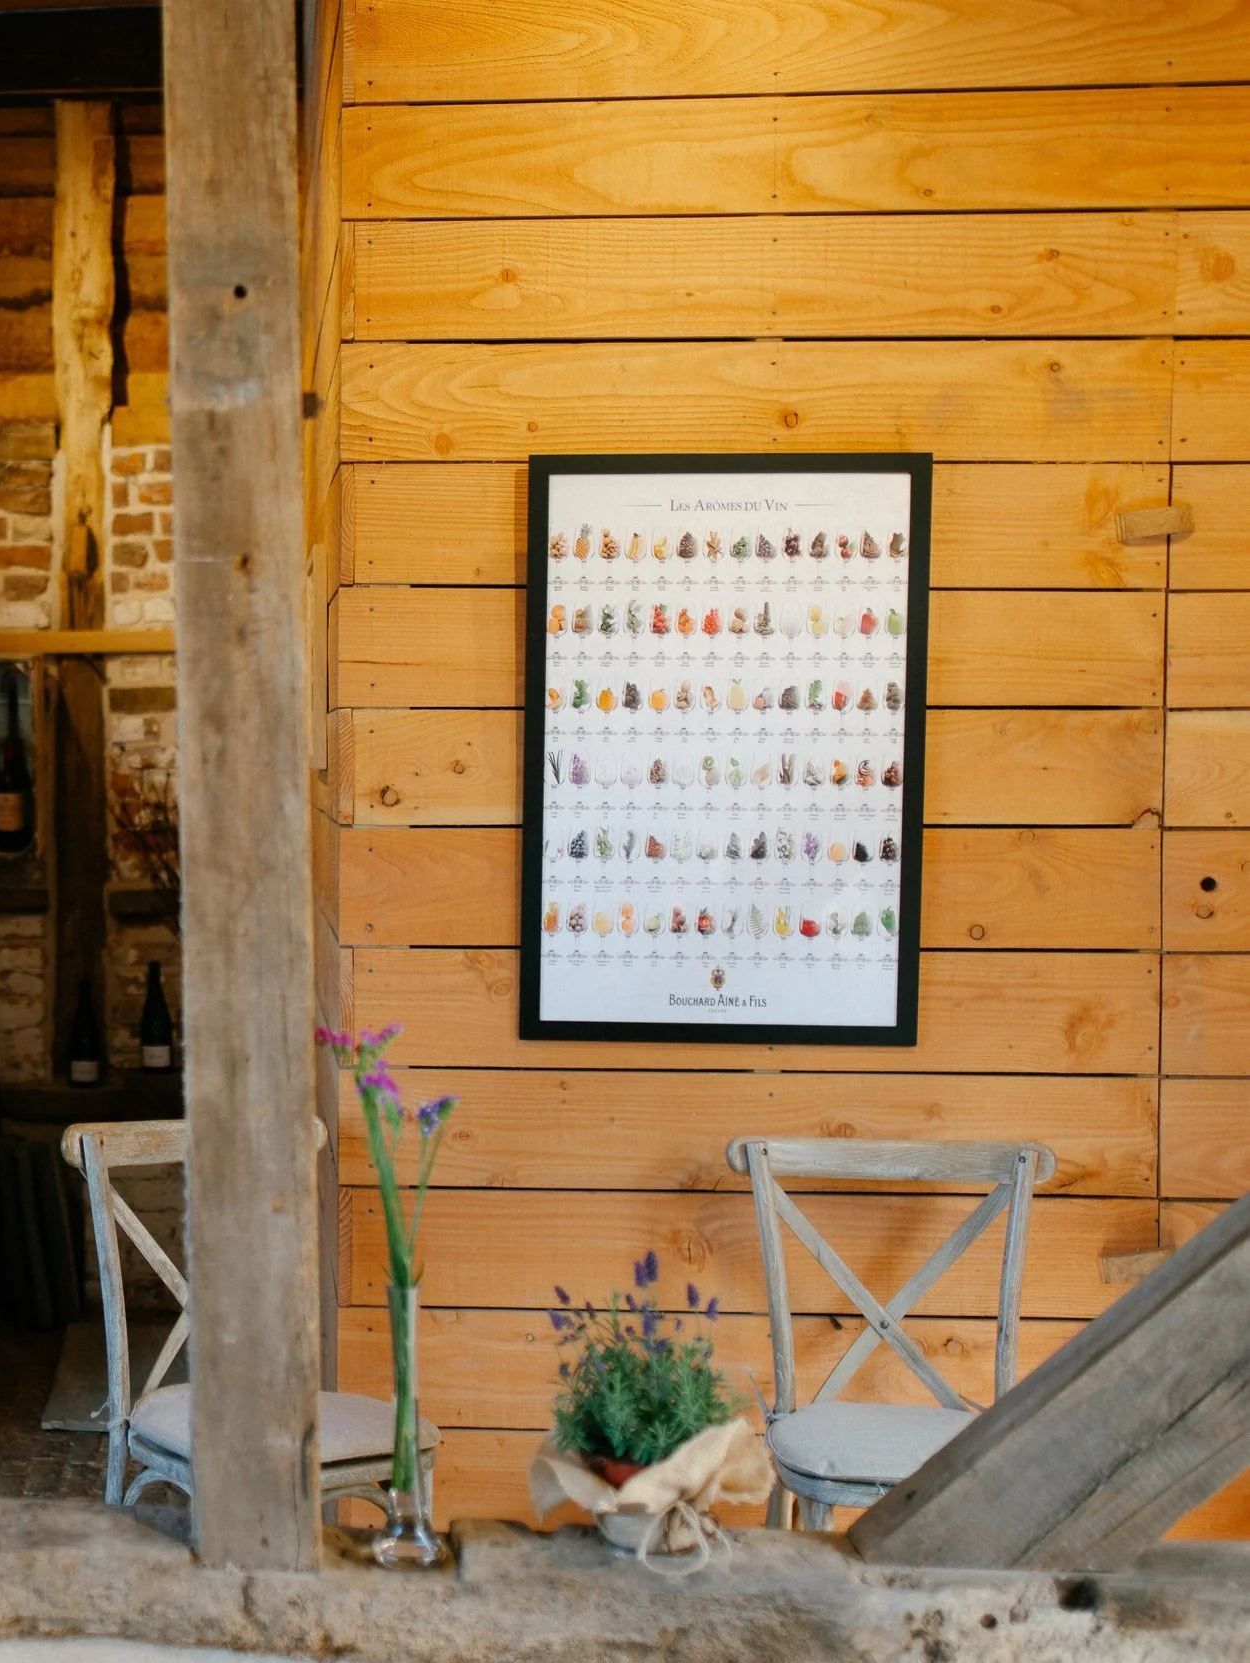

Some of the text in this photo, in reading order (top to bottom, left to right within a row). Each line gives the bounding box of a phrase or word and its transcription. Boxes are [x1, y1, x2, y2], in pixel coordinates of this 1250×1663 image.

[670, 499, 691, 512] LES
[745, 501, 762, 512] DU
[764, 499, 788, 512] VIN
[669, 993, 716, 1007] BOUCHARD
[741, 999, 747, 1007] &
[749, 995, 767, 1008] FILS
